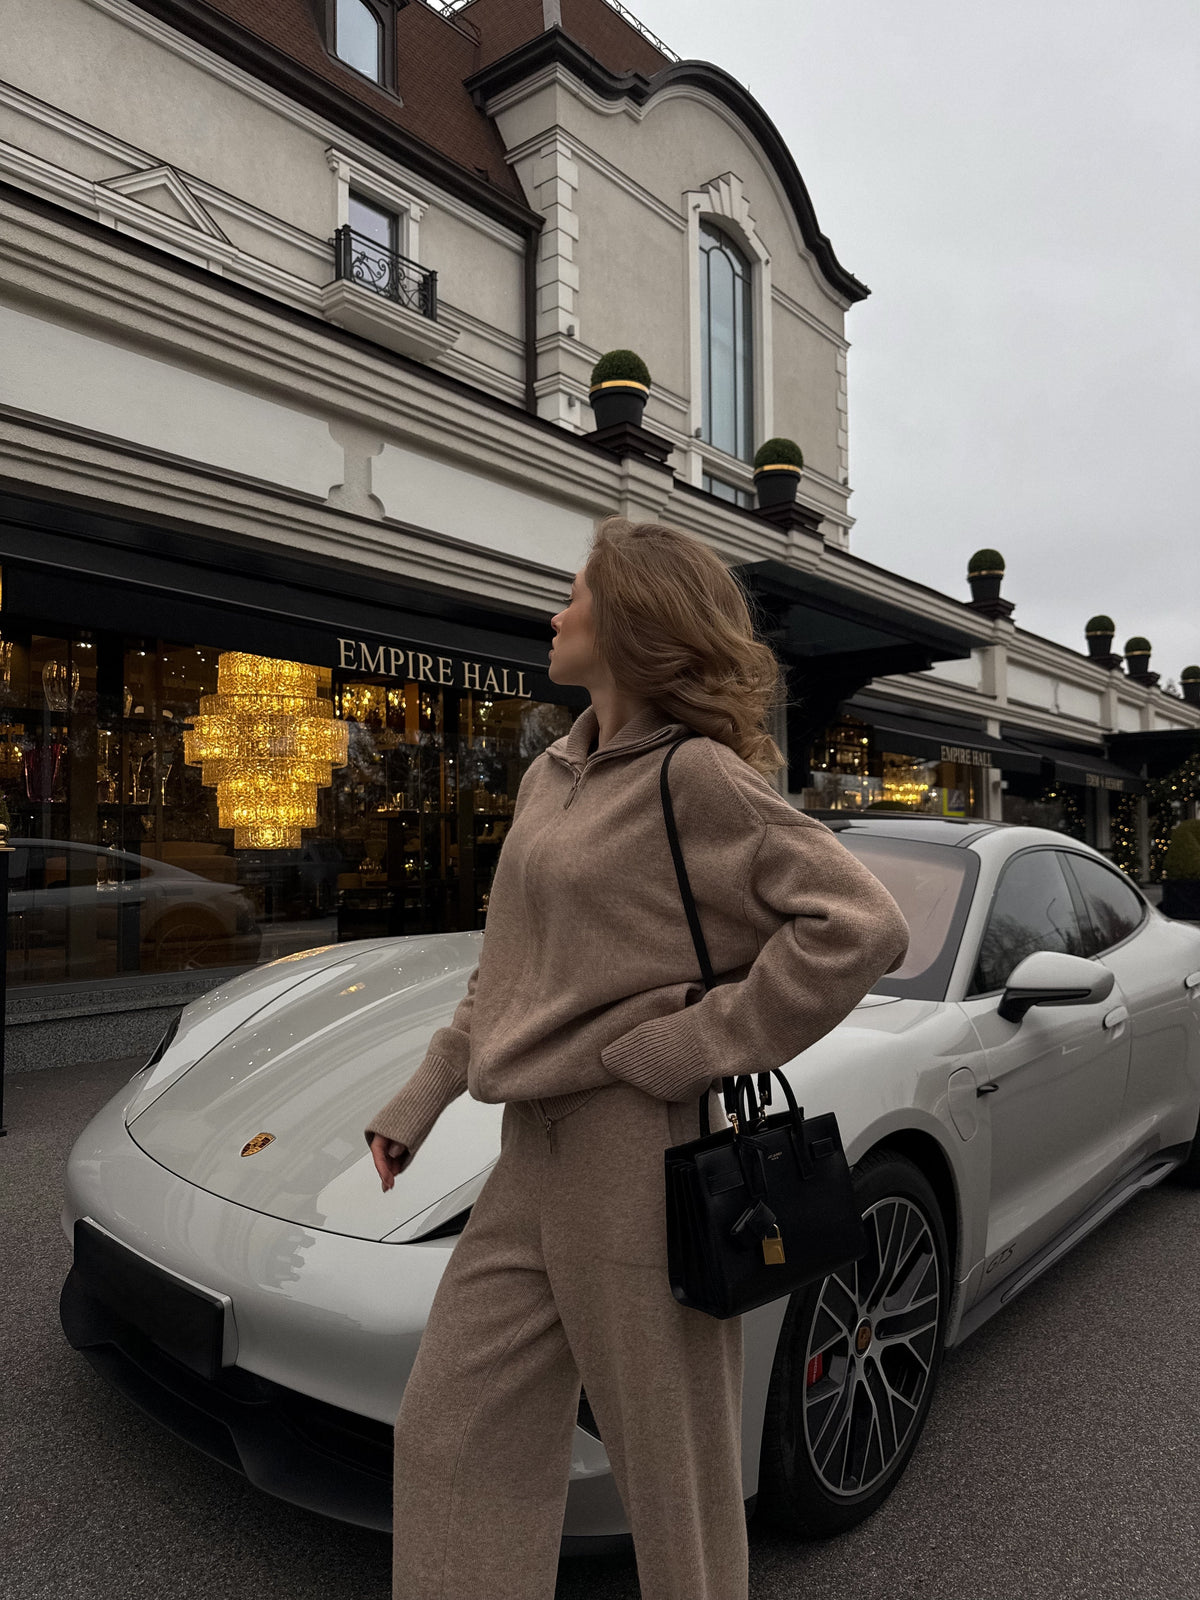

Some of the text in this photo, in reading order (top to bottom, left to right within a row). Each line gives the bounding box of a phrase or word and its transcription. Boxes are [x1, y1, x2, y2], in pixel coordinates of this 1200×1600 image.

[337, 638, 532, 698] EMPIRE HALL
[940, 745, 993, 767] EMPIRE HALL
[986, 1242, 1017, 1274] GTS
